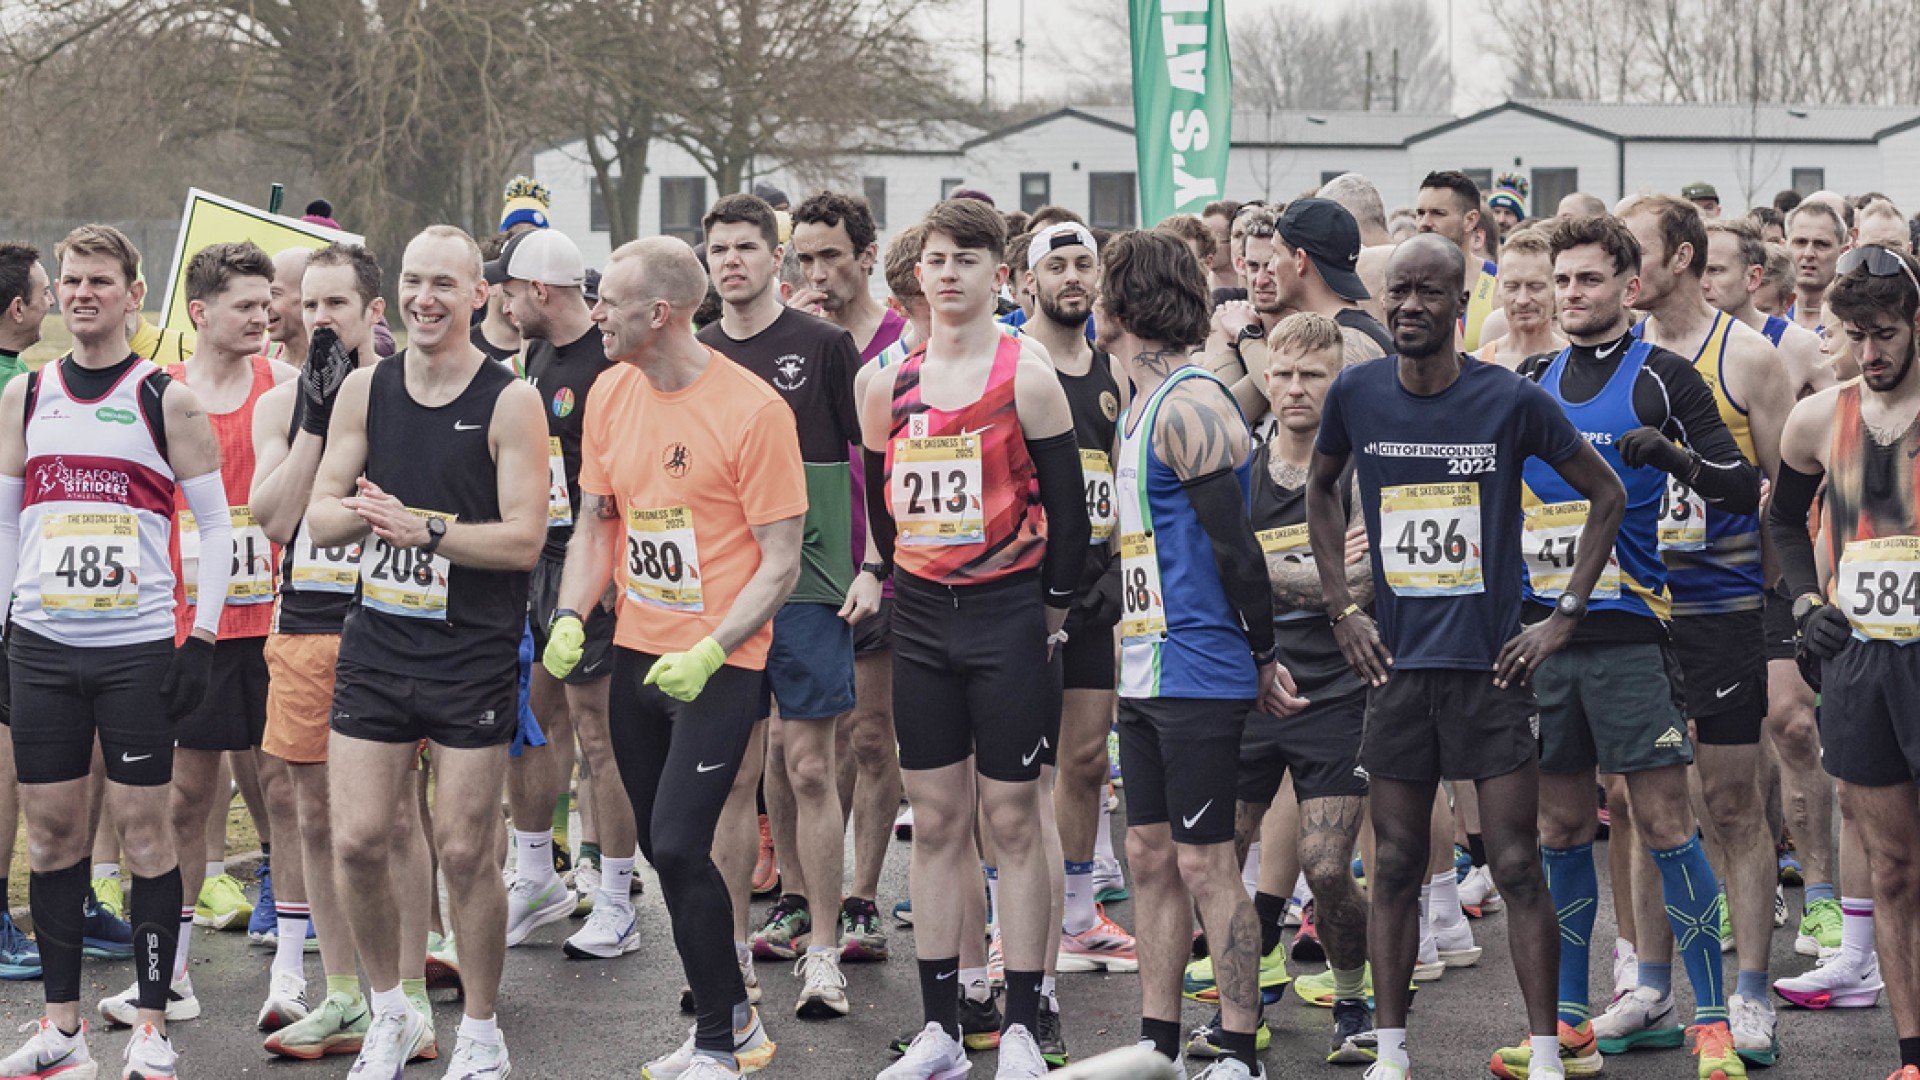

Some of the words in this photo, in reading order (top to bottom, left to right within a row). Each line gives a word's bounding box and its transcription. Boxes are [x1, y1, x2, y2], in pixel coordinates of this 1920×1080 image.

[1169, 109, 1217, 214] Y'S
[63, 468, 130, 485] SLEAFORD
[66, 481, 128, 496] STRIDERS
[1447, 457, 1496, 475] 2022
[903, 469, 967, 514] 213
[1404, 487, 1418, 497] THE
[1419, 485, 1456, 496] SKEGNESS
[370, 538, 434, 586] 208
[627, 535, 684, 583] 380
[1395, 518, 1467, 565] 436
[55, 545, 124, 588] 485
[1122, 566, 1150, 613] 68
[1852, 569, 1920, 616] 584
